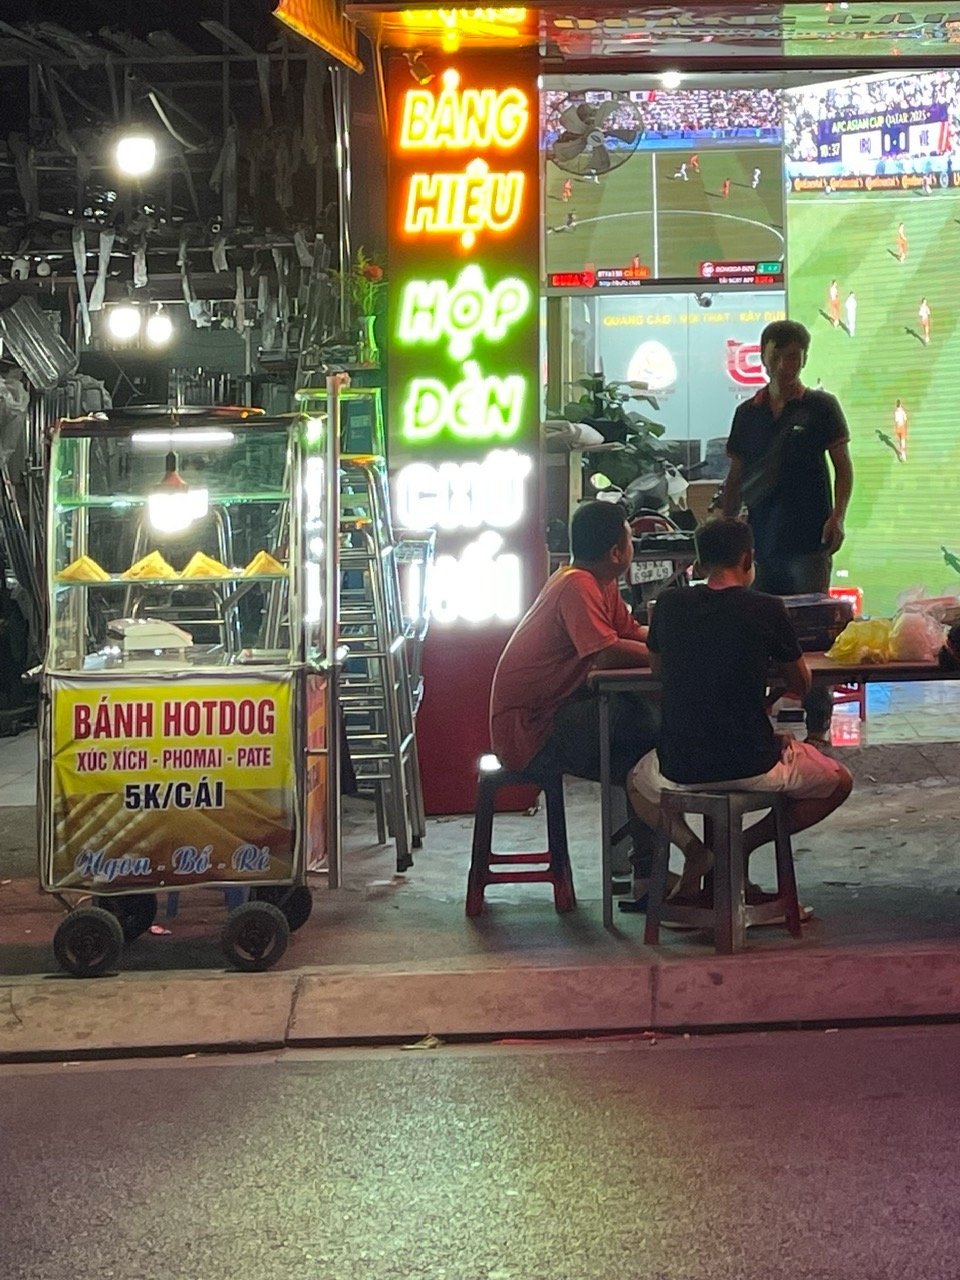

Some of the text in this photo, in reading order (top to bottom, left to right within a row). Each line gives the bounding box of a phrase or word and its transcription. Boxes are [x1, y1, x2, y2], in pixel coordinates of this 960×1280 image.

[400, 68, 528, 149] BẢNG
[404, 158, 524, 250] HIỆU
[73, 696, 276, 741] BÁNH HOTDOG
[76, 747, 108, 773] XÚC
[112, 745, 149, 772] XÍCH
[162, 748, 223, 770] PHOMAI
[236, 746, 272, 768] PATE
[124, 776, 225, 811] 5K/CÁI
